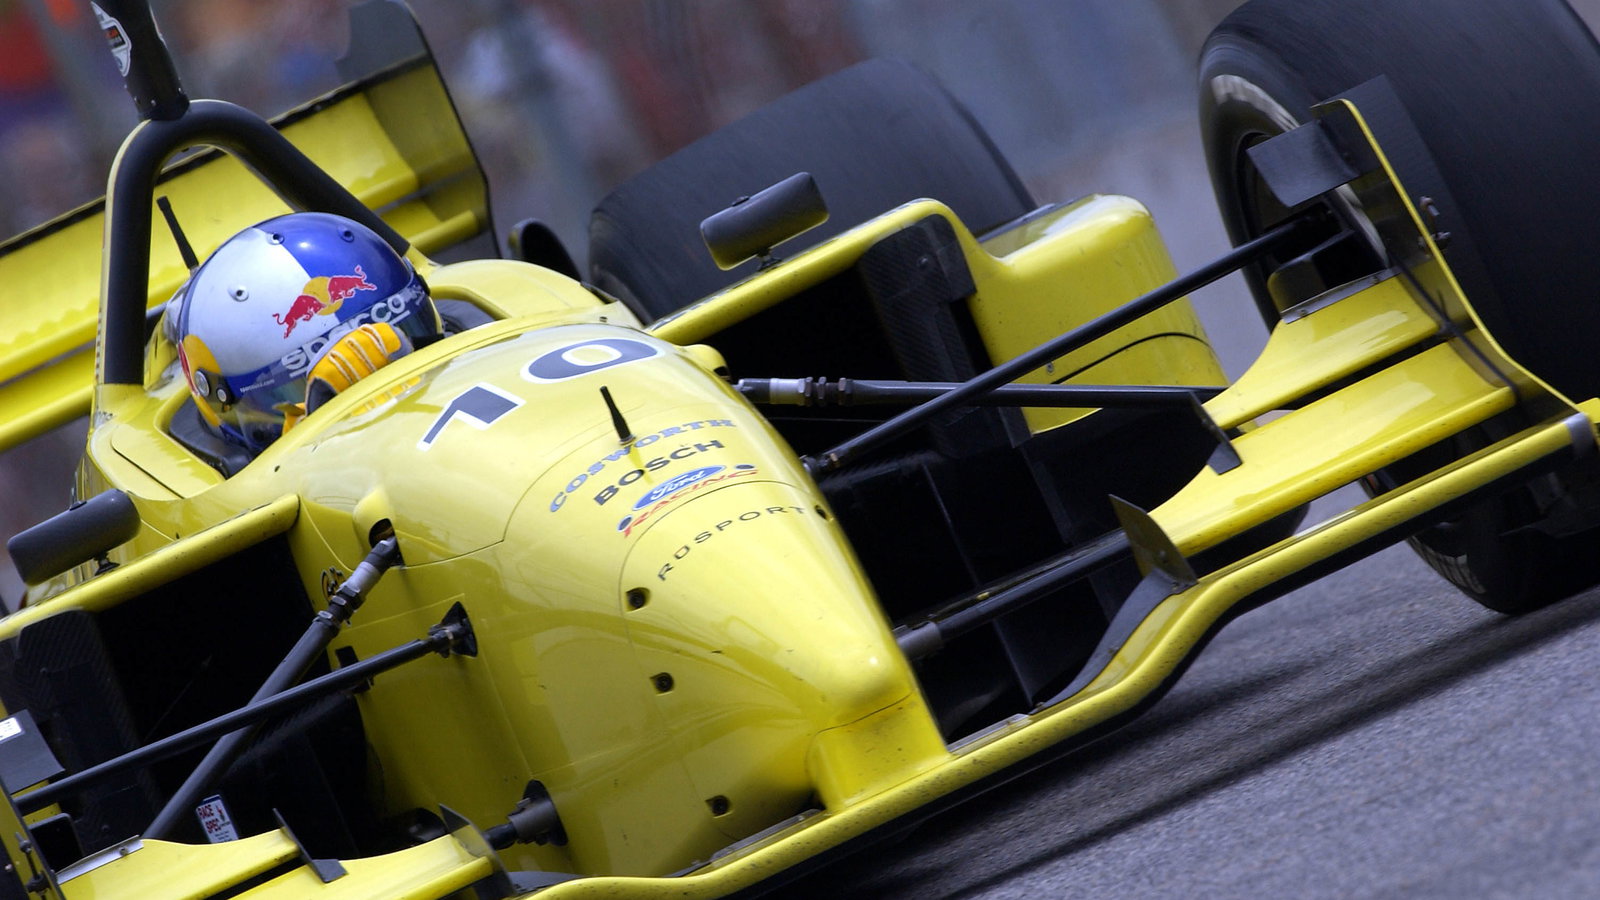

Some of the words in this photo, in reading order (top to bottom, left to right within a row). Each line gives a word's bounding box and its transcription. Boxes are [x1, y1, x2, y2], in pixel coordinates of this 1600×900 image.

[416, 338, 666, 452] 10
[550, 419, 737, 513] COSWORTH
[593, 439, 725, 506] BOSCH
[650, 470, 706, 501] Ford
[624, 469, 758, 537] RACING
